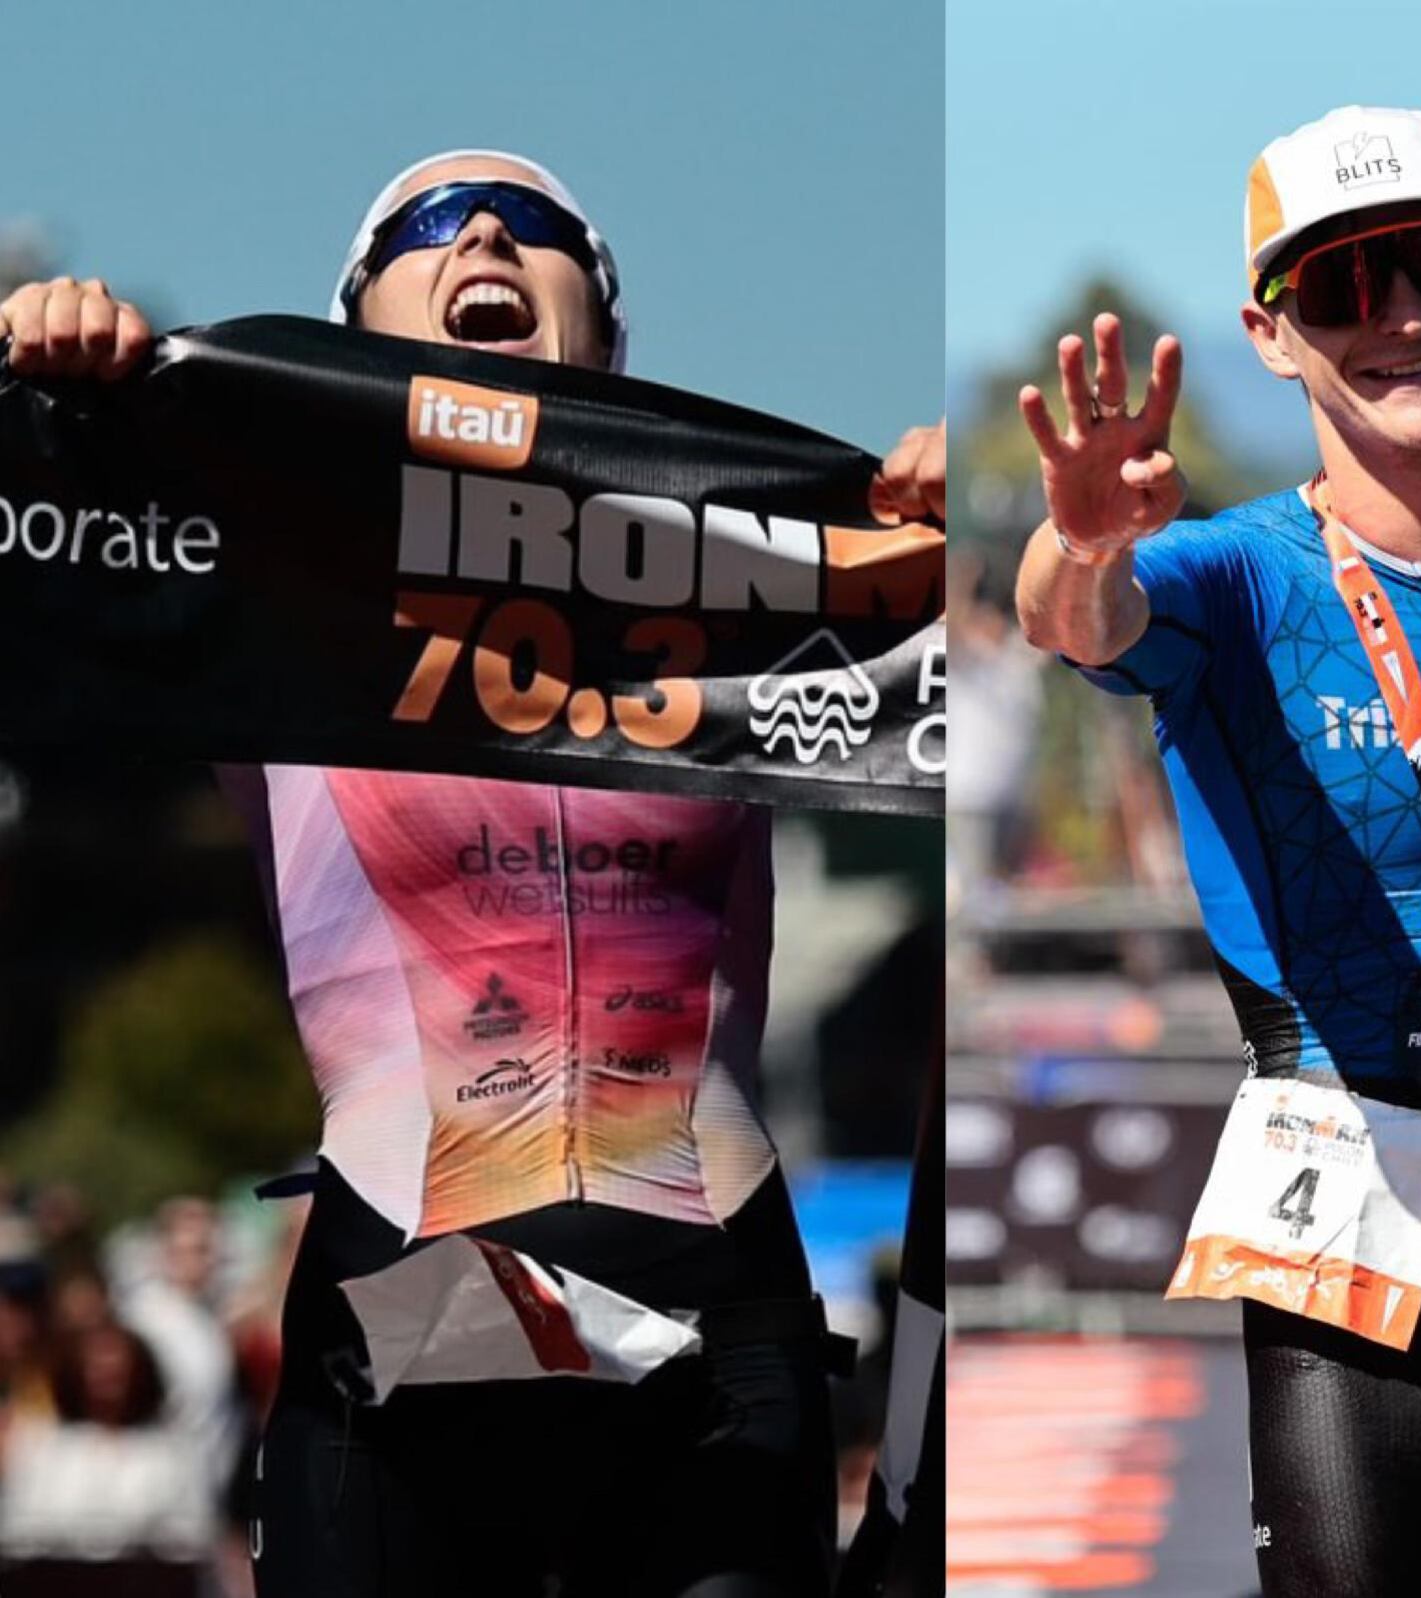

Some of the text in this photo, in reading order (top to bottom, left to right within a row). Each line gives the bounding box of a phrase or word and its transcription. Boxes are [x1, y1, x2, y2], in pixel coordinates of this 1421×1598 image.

[1335, 158, 1403, 184] BLITS
[391, 590, 708, 749] 70.3
[457, 822, 678, 876] deboer
[1268, 1167, 1321, 1240] 4
